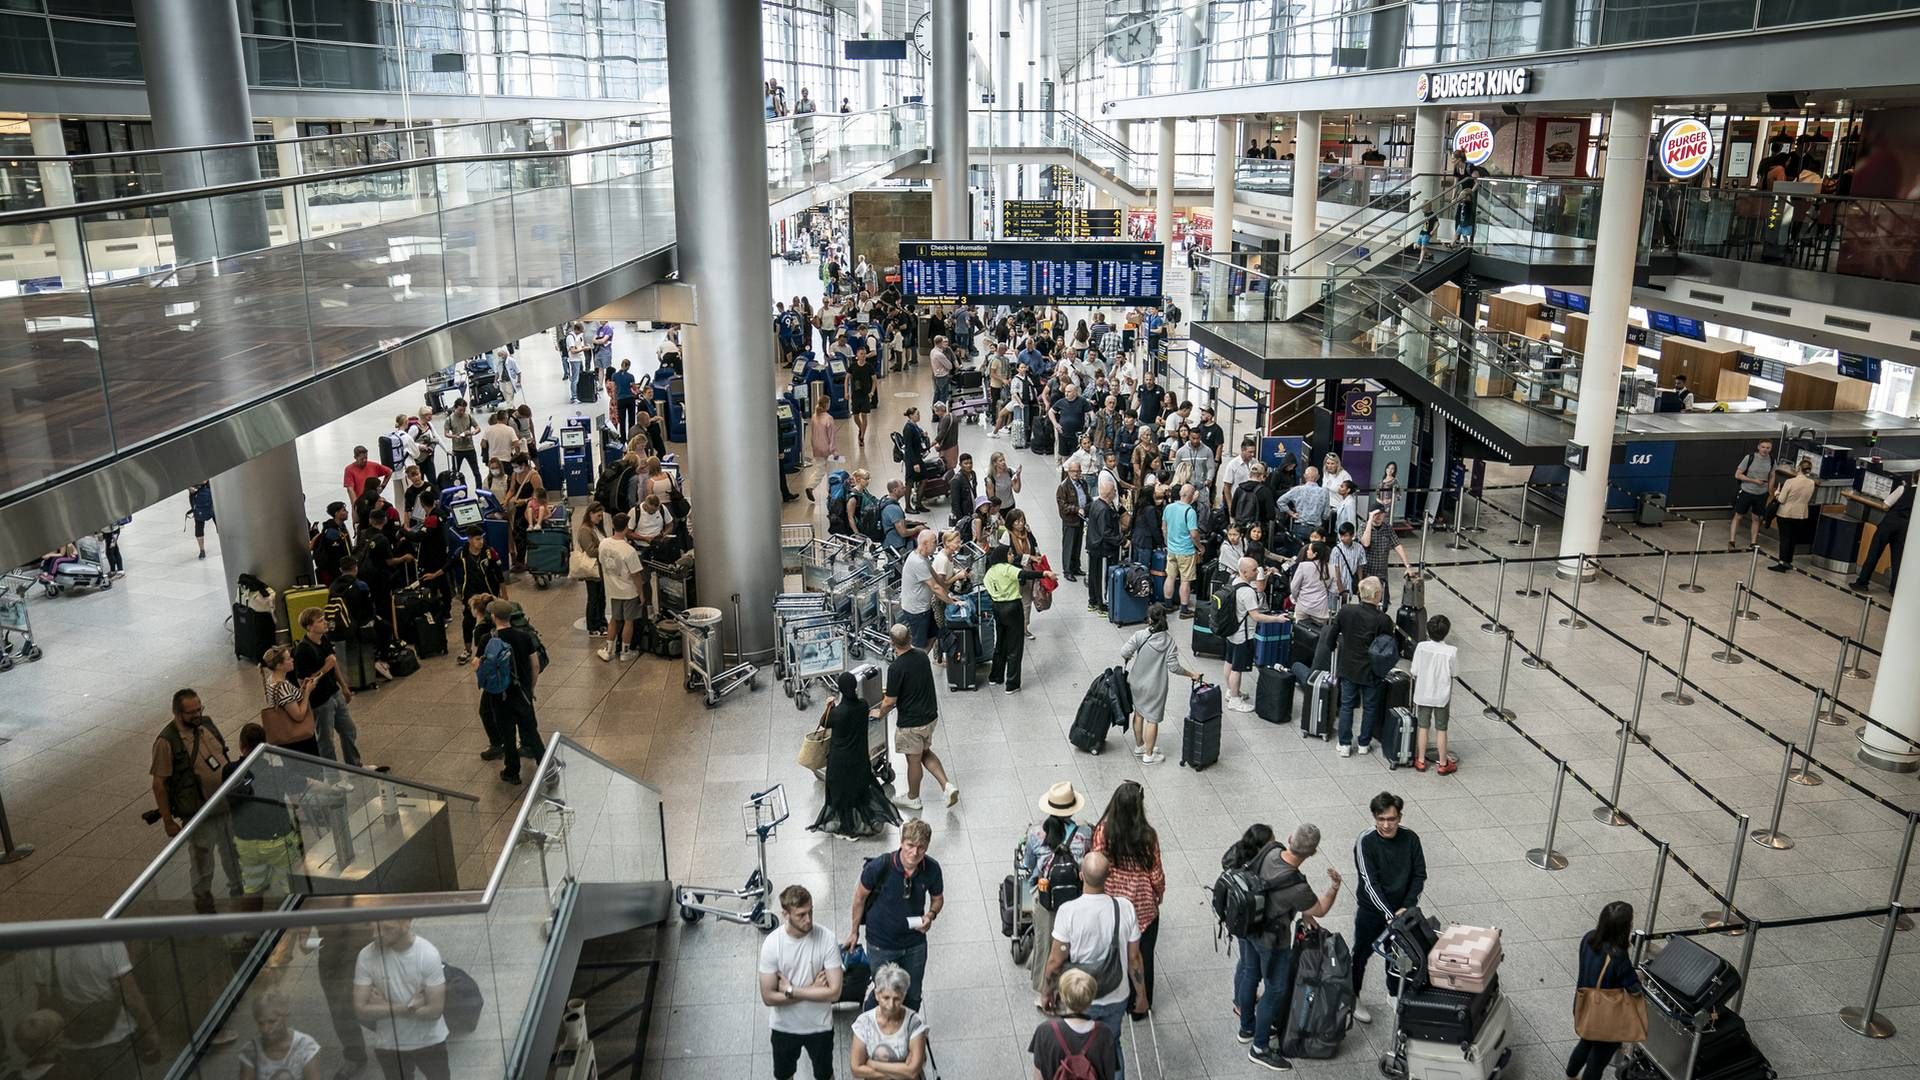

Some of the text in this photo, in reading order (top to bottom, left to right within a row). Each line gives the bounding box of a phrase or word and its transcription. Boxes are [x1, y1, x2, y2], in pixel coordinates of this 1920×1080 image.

[1432, 72, 1485, 98] BURGER
[1487, 68, 1526, 95] KING
[1458, 130, 1489, 145] BURGER
[1668, 131, 1707, 150] BURGER
[1667, 141, 1708, 164] KING
[960, 296, 967, 304] 3
[785, 318, 791, 328] 9
[1629, 454, 1653, 465] SAS
